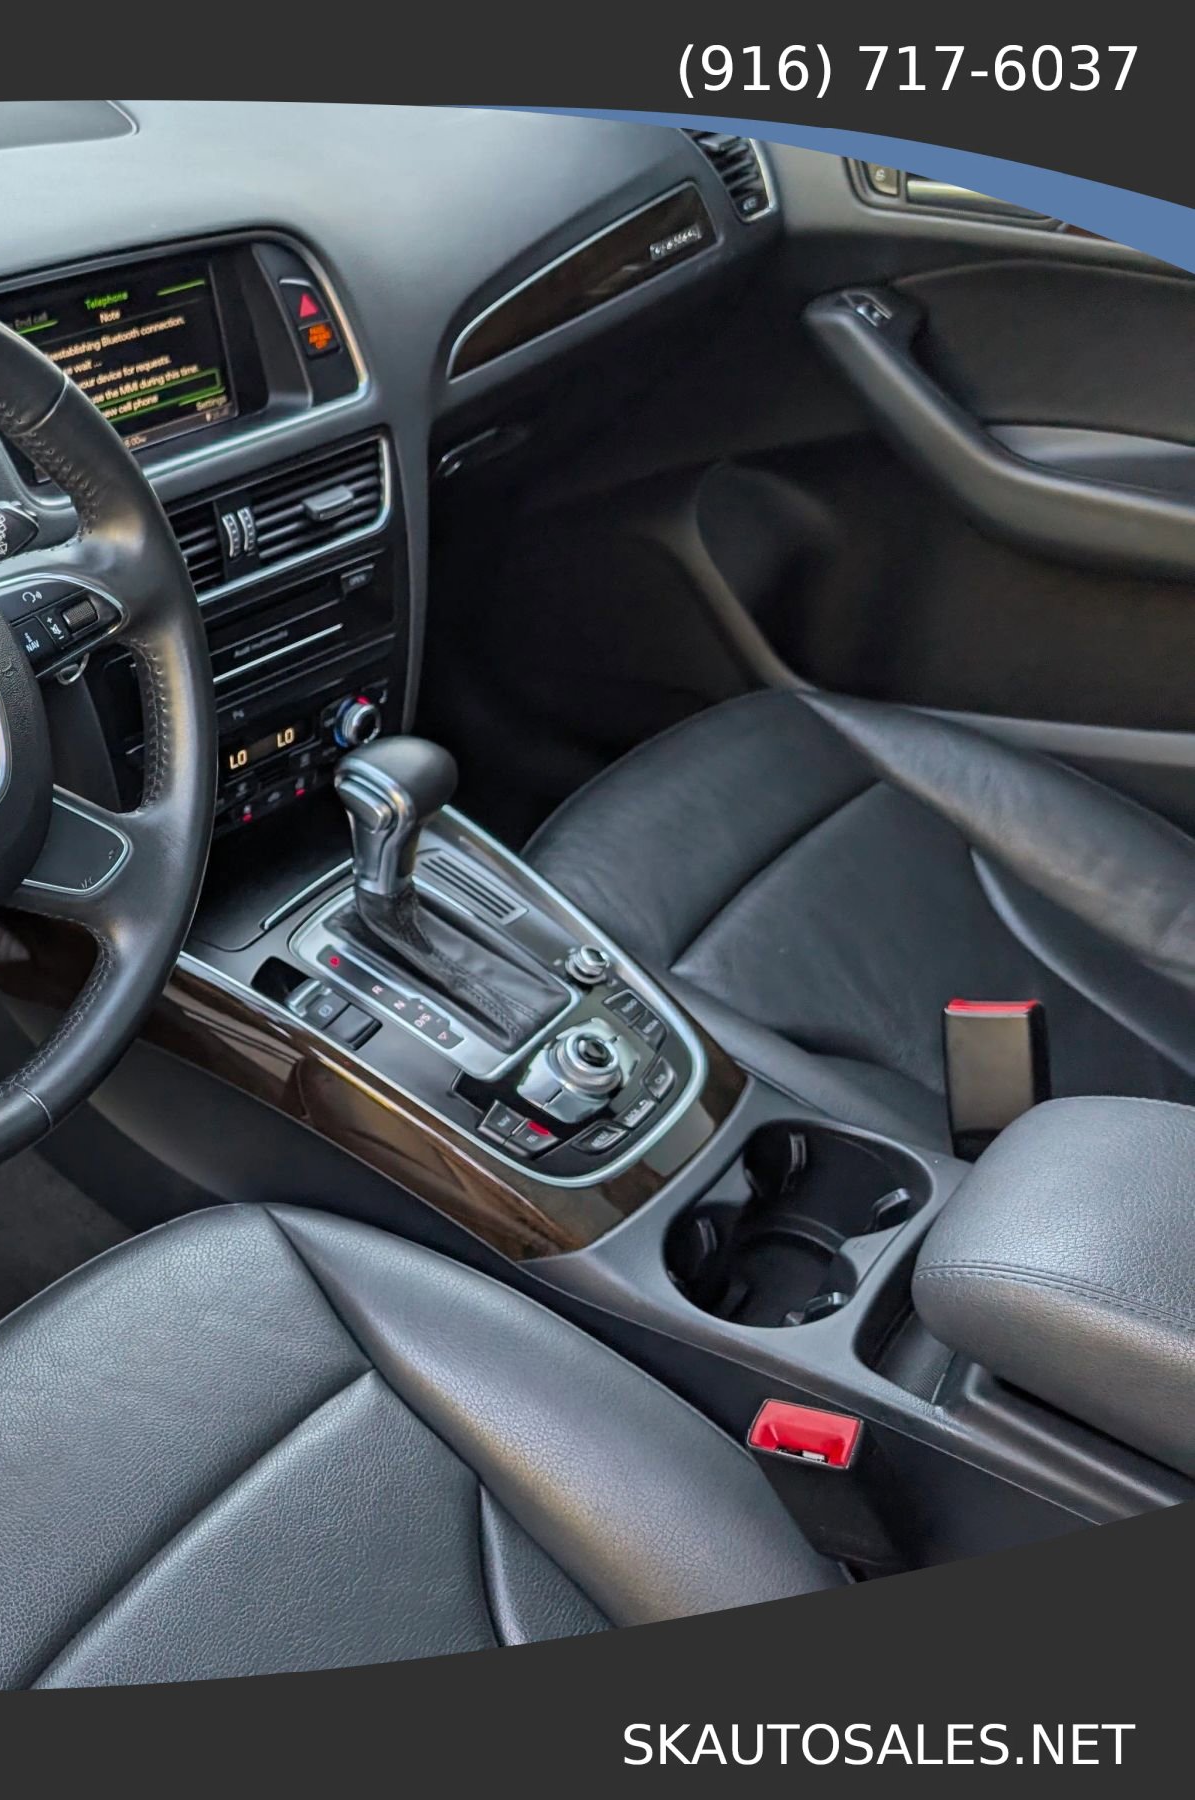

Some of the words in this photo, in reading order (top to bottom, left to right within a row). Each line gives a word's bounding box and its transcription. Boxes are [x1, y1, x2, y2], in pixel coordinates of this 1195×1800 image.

[99, 309, 120, 323] Note
[101, 326, 140, 347] Bluetooth
[140, 316, 185, 336] connection.
[73, 359, 92, 373] wait
[96, 370, 123, 385] device
[123, 366, 135, 376] for
[135, 355, 171, 373] requests.
[104, 388, 119, 400] the
[139, 375, 165, 390] during
[165, 369, 180, 382] this
[119, 401, 132, 414] cell
[132, 394, 159, 411] phone
[25, 640, 40, 653] NAV
[277, 727, 294, 748] LO
[229, 749, 247, 770] LO
